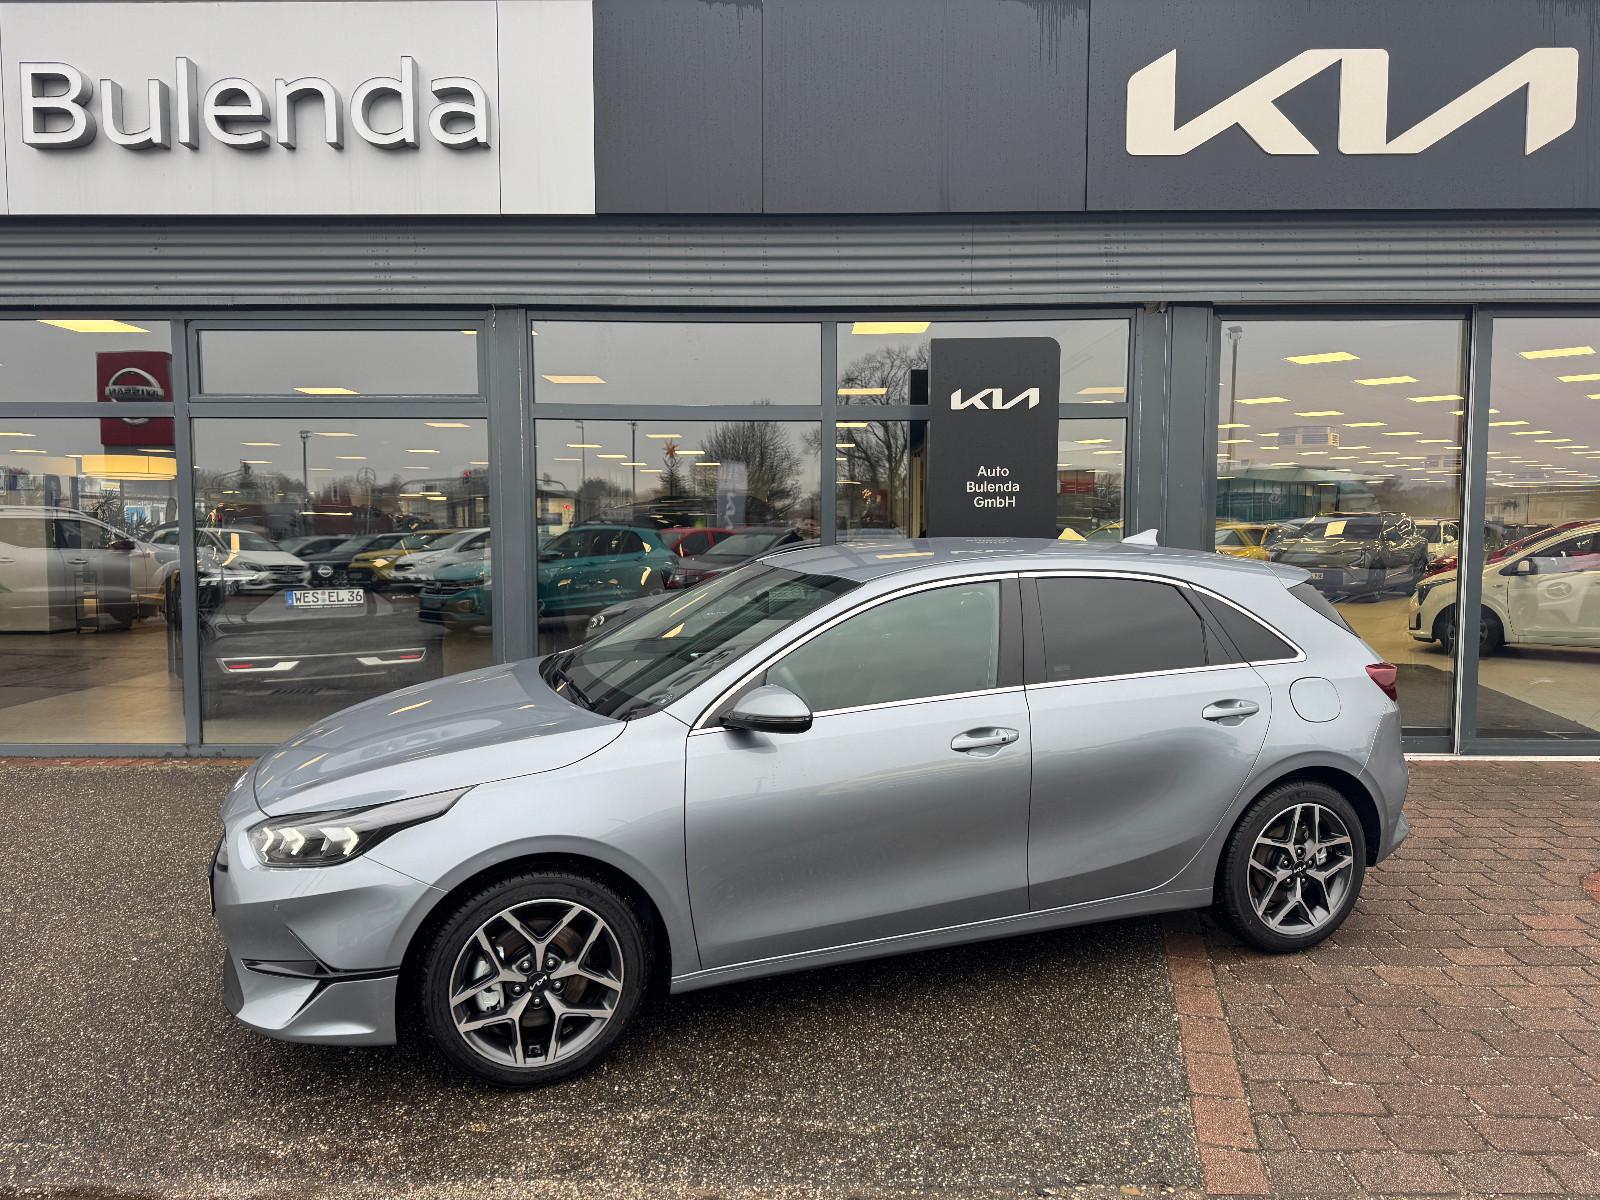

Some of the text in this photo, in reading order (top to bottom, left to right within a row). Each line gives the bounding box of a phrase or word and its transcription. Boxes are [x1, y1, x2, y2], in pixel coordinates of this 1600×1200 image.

[19, 56, 491, 150] Bulenda
[1126, 47, 1579, 156] KIA
[950, 387, 1040, 410] KIA
[977, 465, 1010, 477] Auto
[966, 481, 1020, 493] Bulenda
[973, 496, 1016, 508] GmbH
[294, 590, 363, 604] WES EL 36
